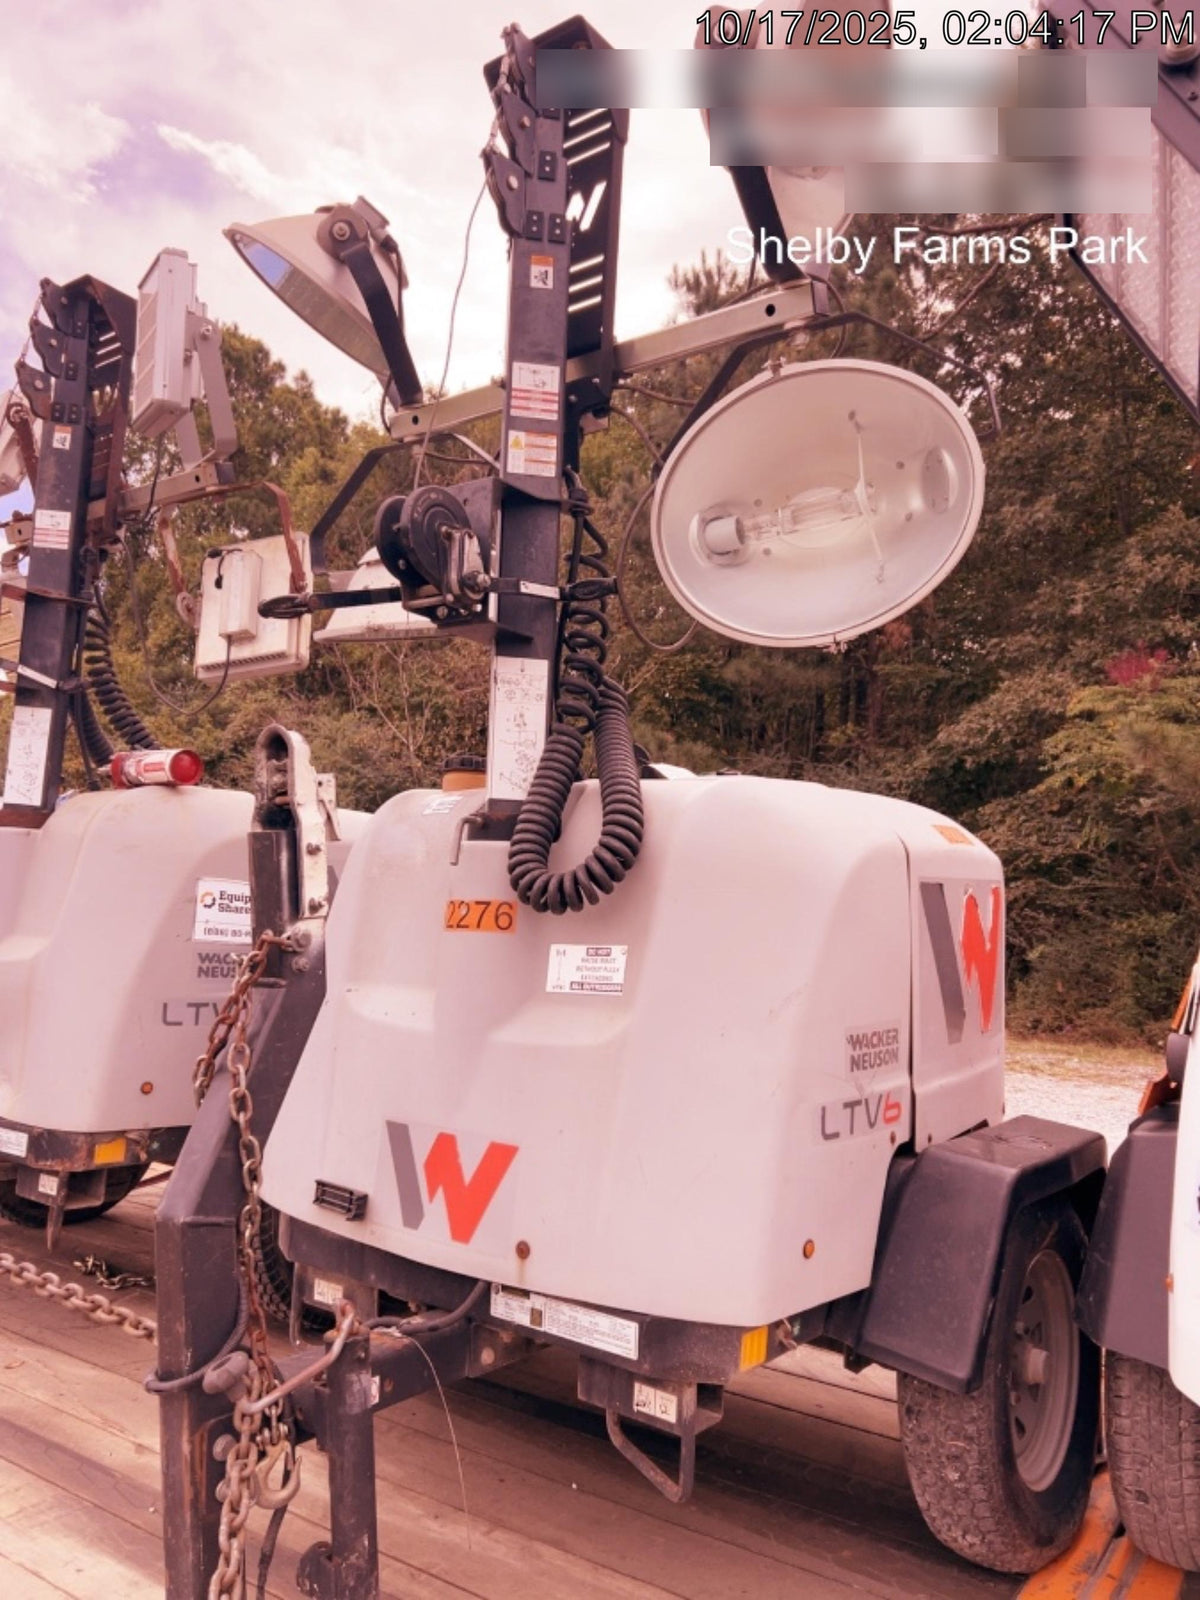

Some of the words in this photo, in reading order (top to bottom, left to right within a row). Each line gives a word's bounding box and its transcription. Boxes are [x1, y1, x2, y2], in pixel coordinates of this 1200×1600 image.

[219, 890, 251, 904] Equip
[446, 900, 513, 930] 2276
[197, 952, 239, 965] WAC
[846, 1028, 899, 1051] WACKER
[850, 1046, 899, 1072] NEUSON
[821, 1090, 902, 1141] LTV6
